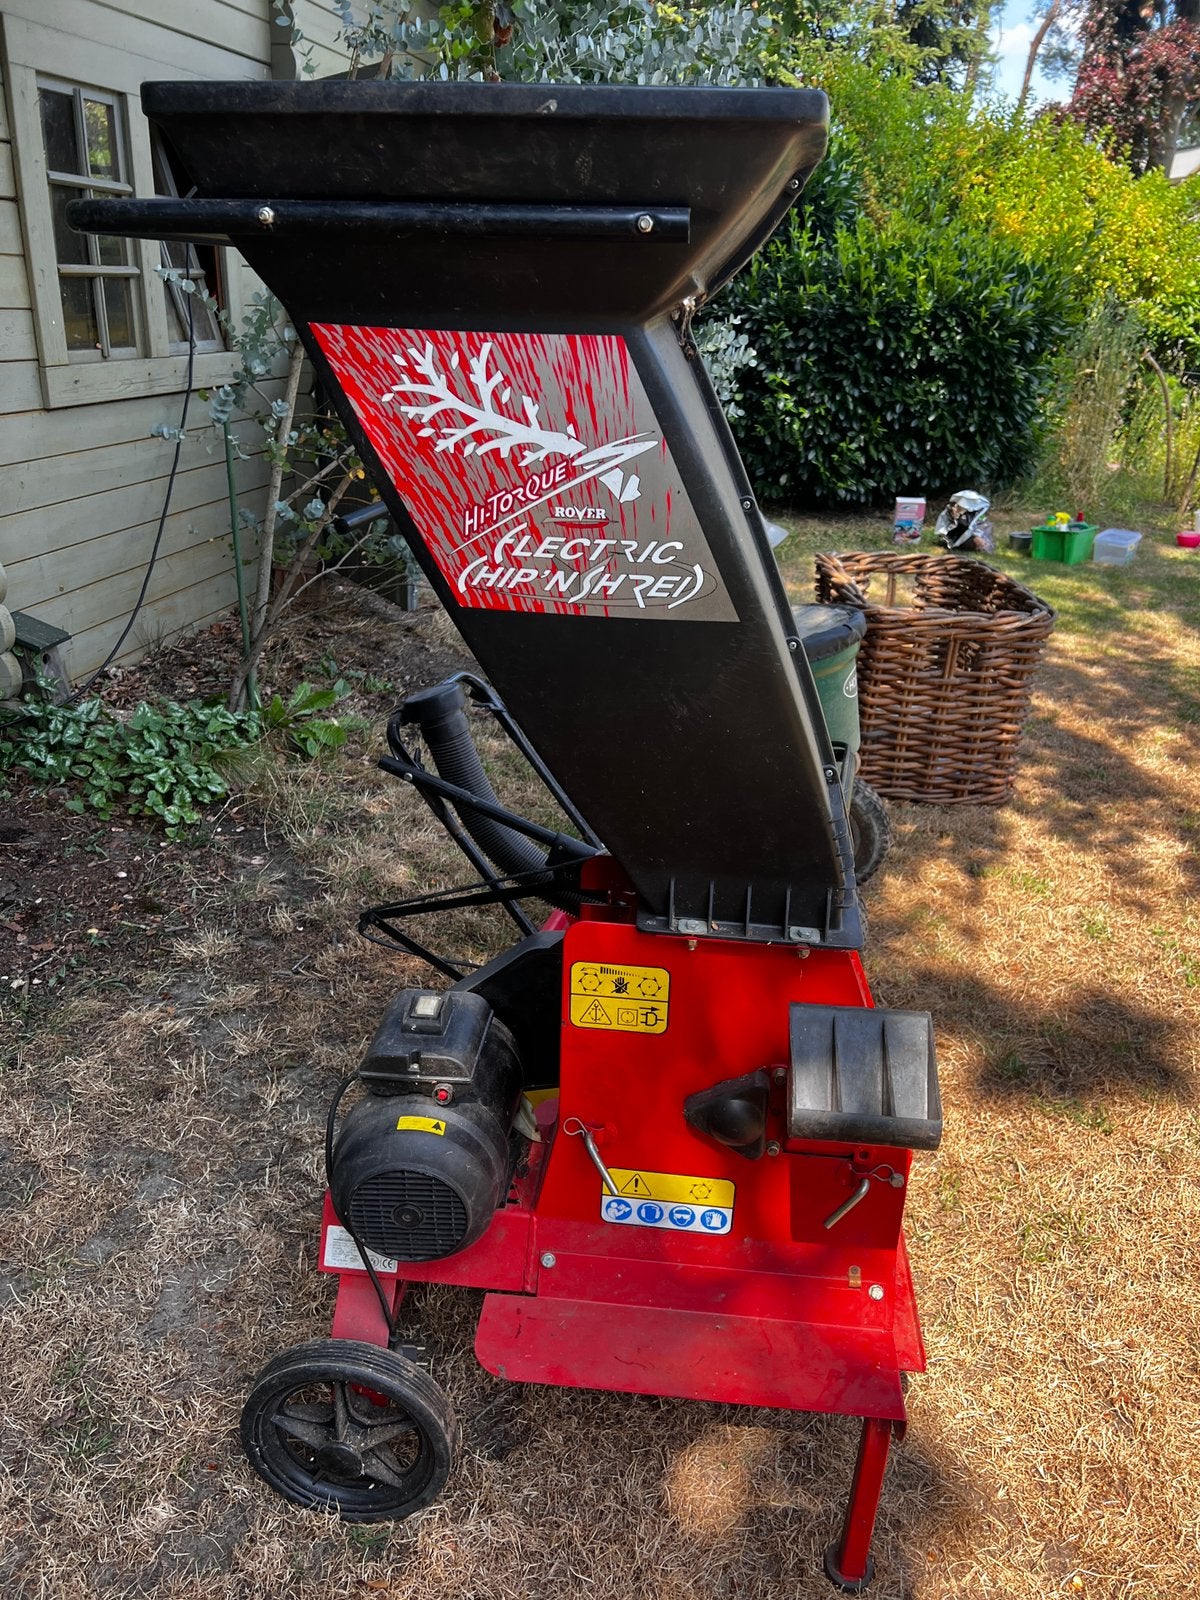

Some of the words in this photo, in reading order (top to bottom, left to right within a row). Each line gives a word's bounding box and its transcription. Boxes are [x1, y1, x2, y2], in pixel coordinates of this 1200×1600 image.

[463, 462, 567, 536] HI-TORQUE
[554, 505, 607, 522] ROVER
[493, 522, 684, 565] ELECTRIC
